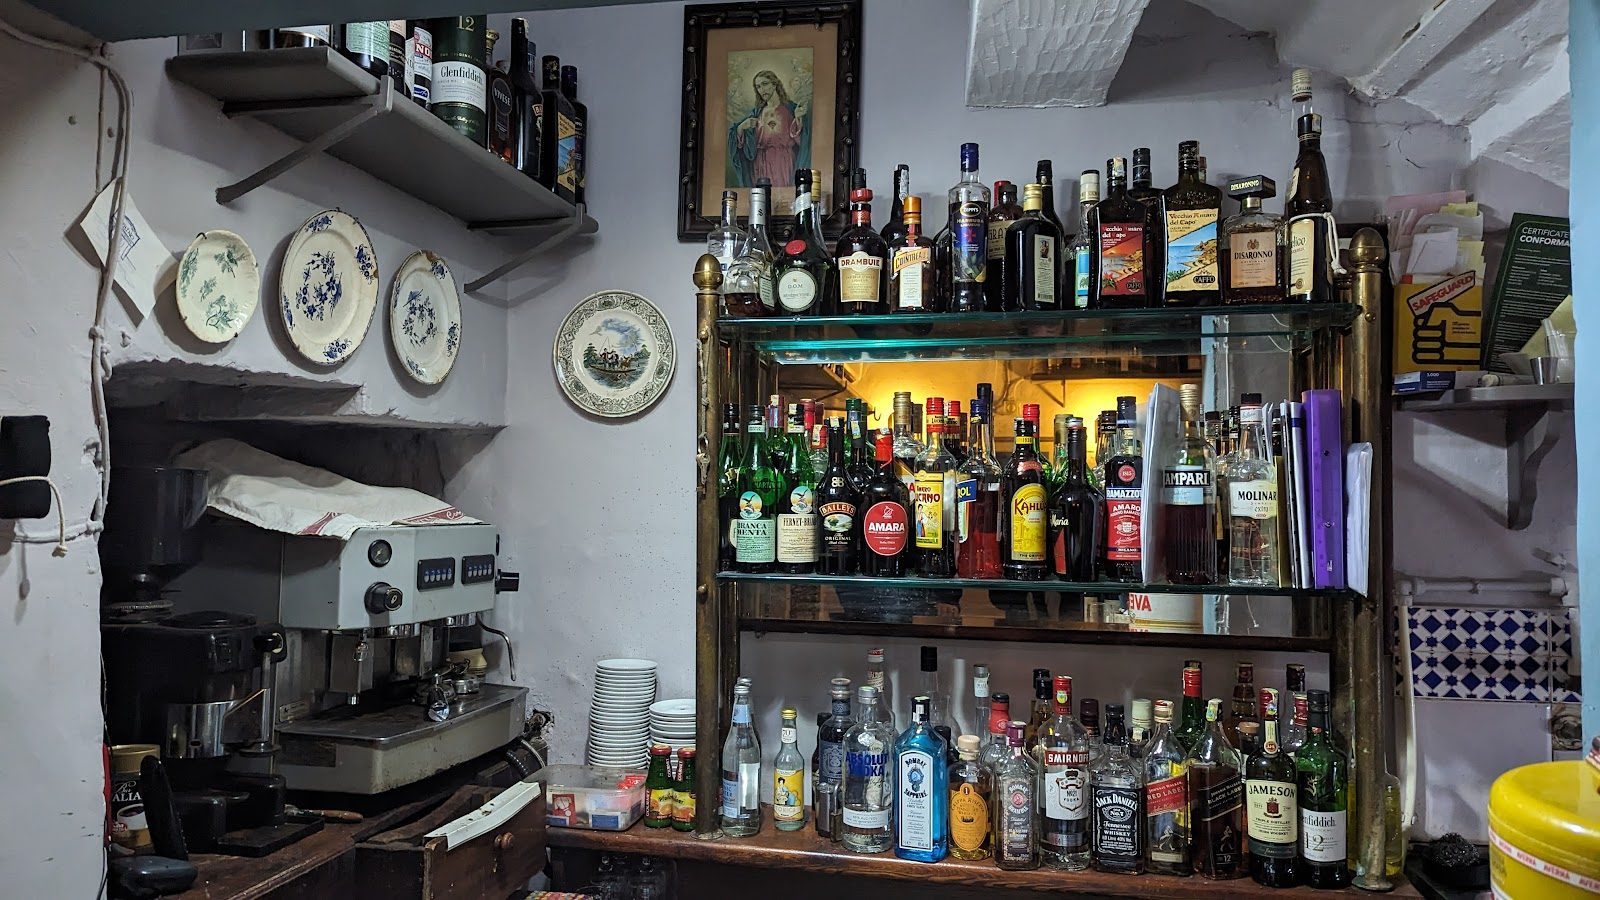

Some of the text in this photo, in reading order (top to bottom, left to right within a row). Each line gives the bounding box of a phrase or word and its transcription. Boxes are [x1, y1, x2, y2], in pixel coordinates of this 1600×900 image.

[457, 15, 475, 32] 12
[441, 65, 483, 84] Glenfiddich
[1230, 180, 1259, 191] DISARONNO
[1522, 227, 1569, 238] CERTIFICATE
[1235, 250, 1273, 260] DISARONNO
[841, 259, 880, 267] DRAMBUIE
[1194, 275, 1215, 283] CAFFO
[1412, 275, 1473, 311] SAFEGUARD
[821, 502, 855, 514] BAILEYS
[1112, 503, 1141, 513] AMARO
[868, 522, 905, 532] AMARA
[905, 757, 927, 768] BOMBAY
[1147, 785, 1185, 800] RED LABEL
[1249, 784, 1295, 798] JAMESON
[1096, 796, 1112, 808] JACK
[1103, 820, 1131, 829] Tennessee
[1304, 831, 1324, 852] 12
[1224, 854, 1232, 862] 12
[1543, 864, 1570, 881] AVERNA
